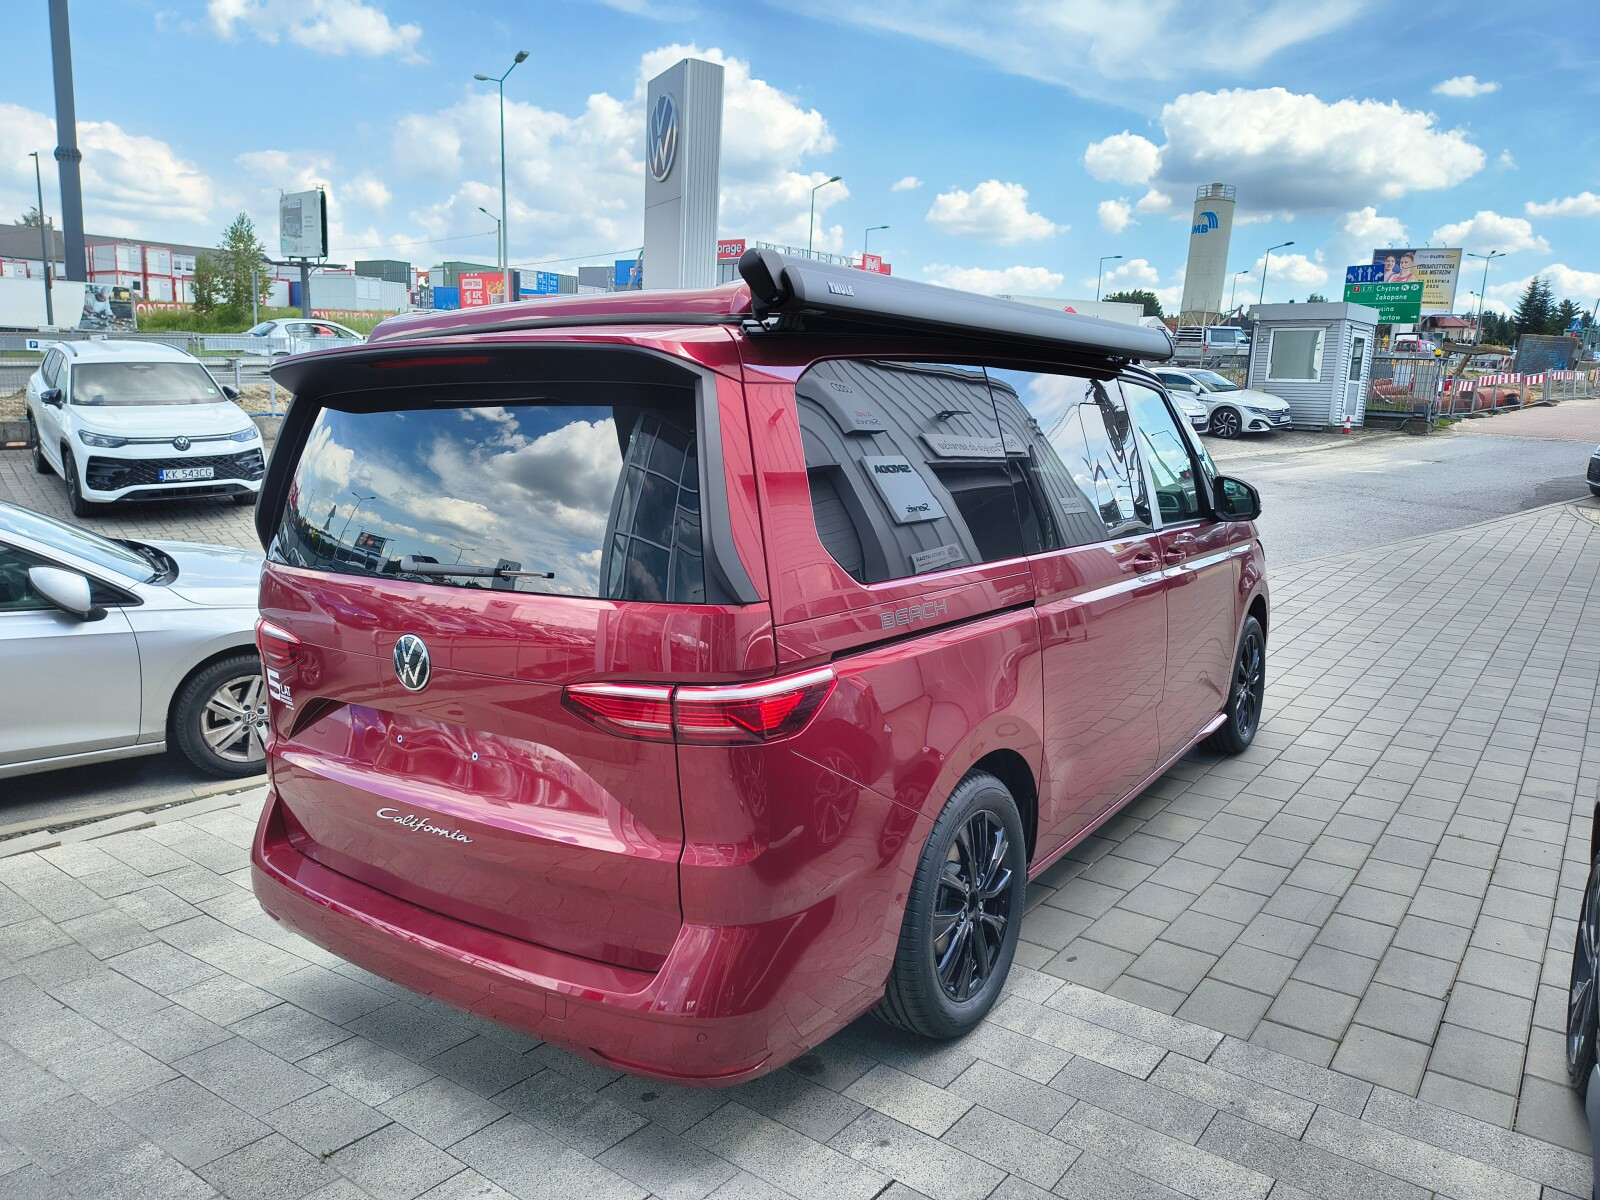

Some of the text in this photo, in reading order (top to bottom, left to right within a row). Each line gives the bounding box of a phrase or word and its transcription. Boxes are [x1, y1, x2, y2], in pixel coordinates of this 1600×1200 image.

[717, 243, 743, 257] orage
[472, 290, 483, 298] KFC
[827, 281, 855, 297] THULE
[165, 468, 212, 480] KK 543CG
[881, 598, 948, 630] BEACH
[376, 807, 474, 843] California
